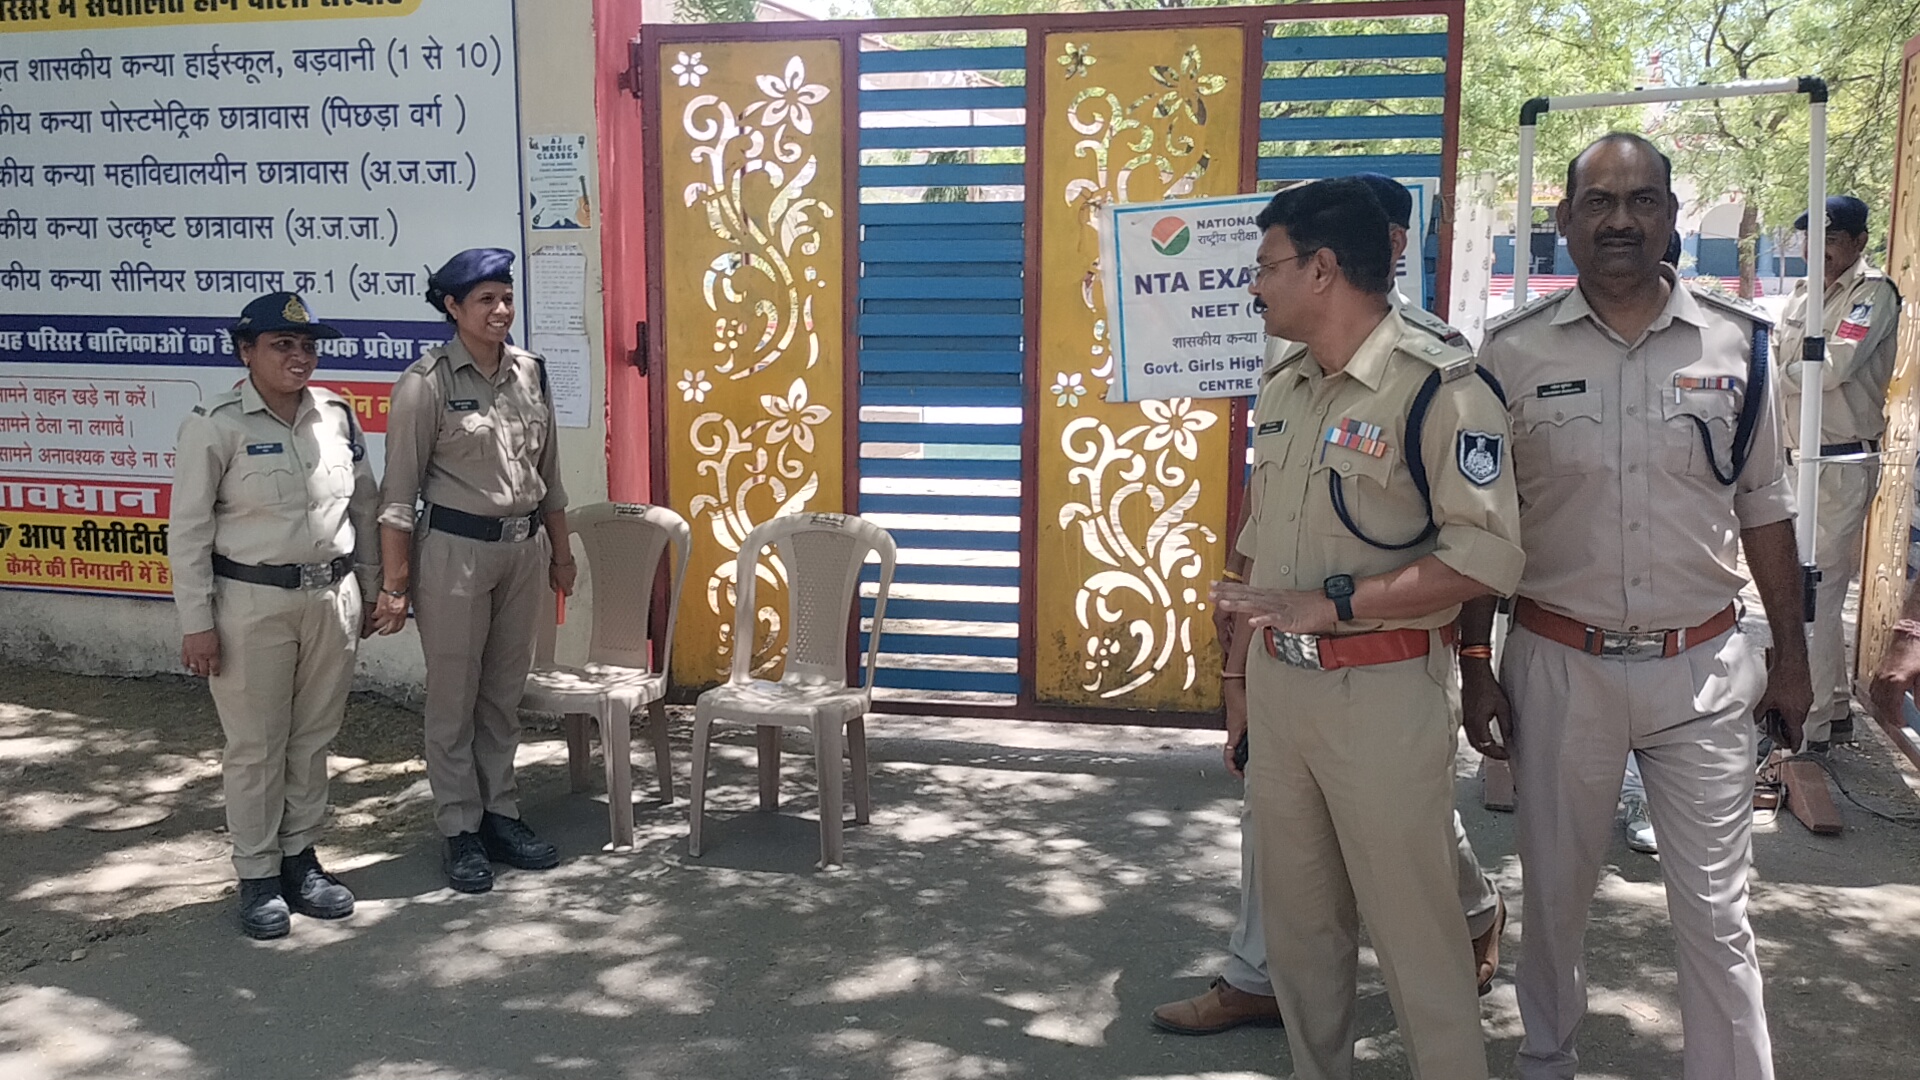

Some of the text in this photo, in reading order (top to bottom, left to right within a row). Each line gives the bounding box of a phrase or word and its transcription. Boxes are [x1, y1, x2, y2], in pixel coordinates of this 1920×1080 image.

[28, 48, 112, 82] शासकीय
[121, 54, 175, 78] कन्या
[184, 44, 283, 84] हाईस्कूल,
[292, 37, 375, 76] बड़वानी
[387, 37, 408, 78] (1
[421, 35, 443, 70] से
[456, 34, 501, 76] 10)
[40, 111, 92, 134] कन्या
[100, 99, 209, 139] पोस्टमेट्रिक
[218, 105, 310, 130] छात्रावास
[321, 96, 399, 136] (पिछड़ा
[536, 152, 578, 160] CLASSES
[42, 165, 95, 187] कन्या
[103, 152, 248, 188] महाविद्यालयीन
[256, 161, 349, 185] छात्रावास
[361, 151, 476, 192] (अ.ज.जा.)
[46, 217, 98, 239] कन्या
[106, 217, 176, 249] उत्कृष्ट
[184, 216, 274, 239] छात्रावास
[285, 207, 398, 247] (अ.ज.जा.)
[1196, 215, 1256, 229] NATIONA
[1197, 228, 1257, 246] राष्ट्रीय परीक्षा
[49, 270, 101, 291] कन्या
[110, 261, 186, 292] सीनियर
[194, 270, 286, 293] छात्रावास
[1135, 266, 1251, 295] NTA EXA
[1191, 303, 1240, 319] NEET
[0, 331, 24, 350] यह
[26, 326, 83, 352] परिसर
[86, 327, 186, 355] बालिकाओं
[188, 335, 216, 355] का
[362, 332, 413, 360] प्रवेश
[1172, 331, 1221, 348] शासकीय
[1226, 332, 1257, 345] कन्या
[1143, 355, 1264, 375] Govt. Girls High
[33, 388, 66, 406] वाहन
[72, 383, 98, 408] खड़े
[104, 390, 120, 406] ना
[1199, 378, 1253, 392] CENTRE
[35, 412, 62, 434] ठेला
[67, 419, 83, 435] ना
[0, 441, 32, 462] सामने
[38, 449, 105, 466] अनावश्यक
[110, 445, 137, 469] खड़े
[142, 452, 158, 469] ना
[19, 523, 66, 549] आप
[5, 553, 42, 577] कैमरे
[45, 556, 66, 578] की
[70, 557, 133, 582] निगरानी
[138, 561, 154, 584] में
